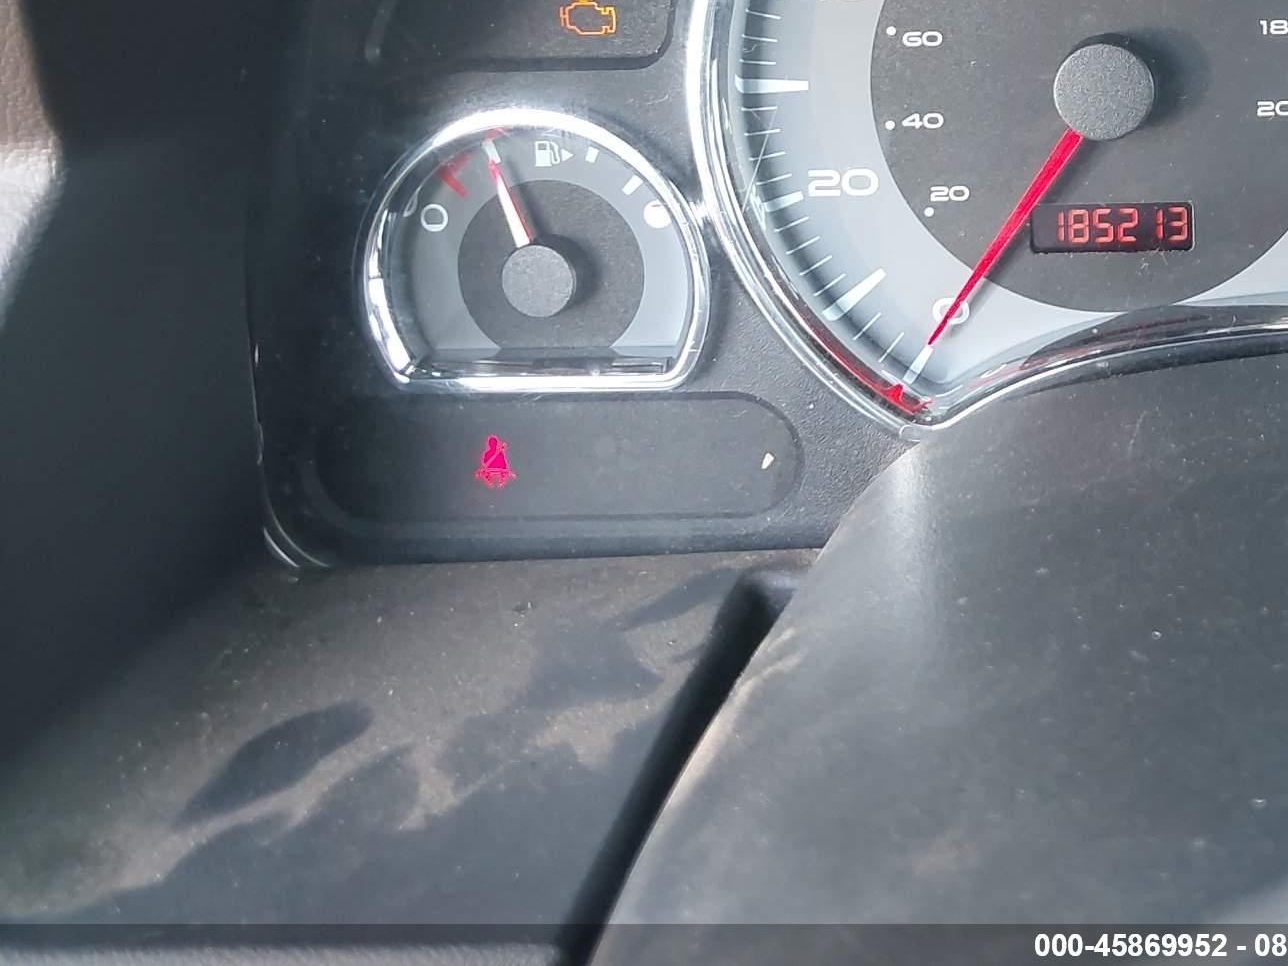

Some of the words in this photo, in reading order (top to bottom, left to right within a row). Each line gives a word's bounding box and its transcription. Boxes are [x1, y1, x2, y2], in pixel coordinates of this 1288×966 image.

[902, 30, 943, 48] 60
[902, 113, 944, 130] 40
[807, 169, 879, 196] 20
[929, 186, 970, 202] 20
[1056, 206, 1189, 243] 185213
